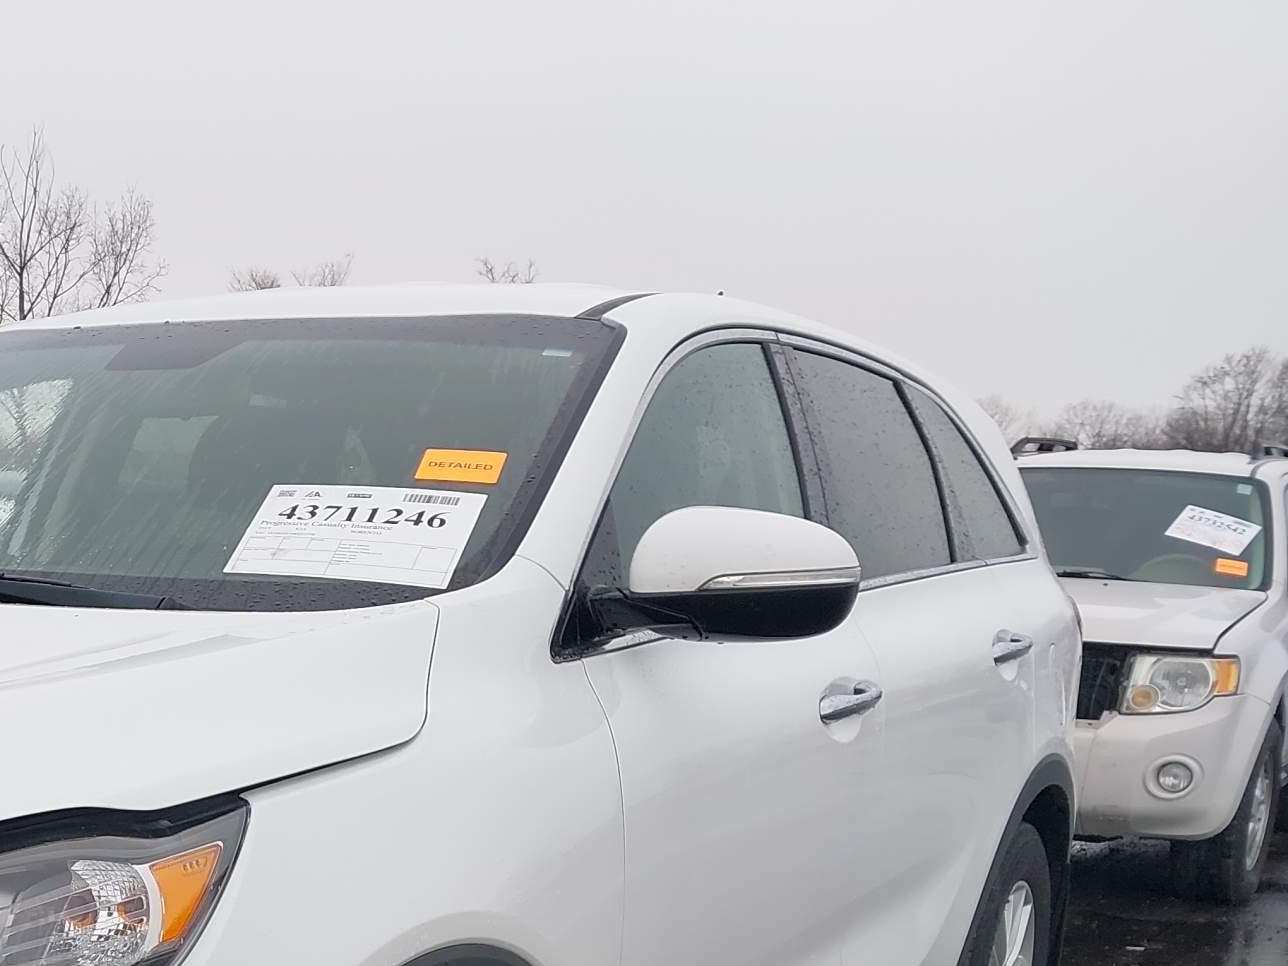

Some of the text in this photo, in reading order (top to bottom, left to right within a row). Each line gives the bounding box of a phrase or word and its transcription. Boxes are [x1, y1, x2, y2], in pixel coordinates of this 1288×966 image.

[428, 461, 494, 471] DETAILED
[277, 504, 450, 529] 43711246
[311, 521, 347, 529] Casualty
[350, 523, 394, 531] Insurance
